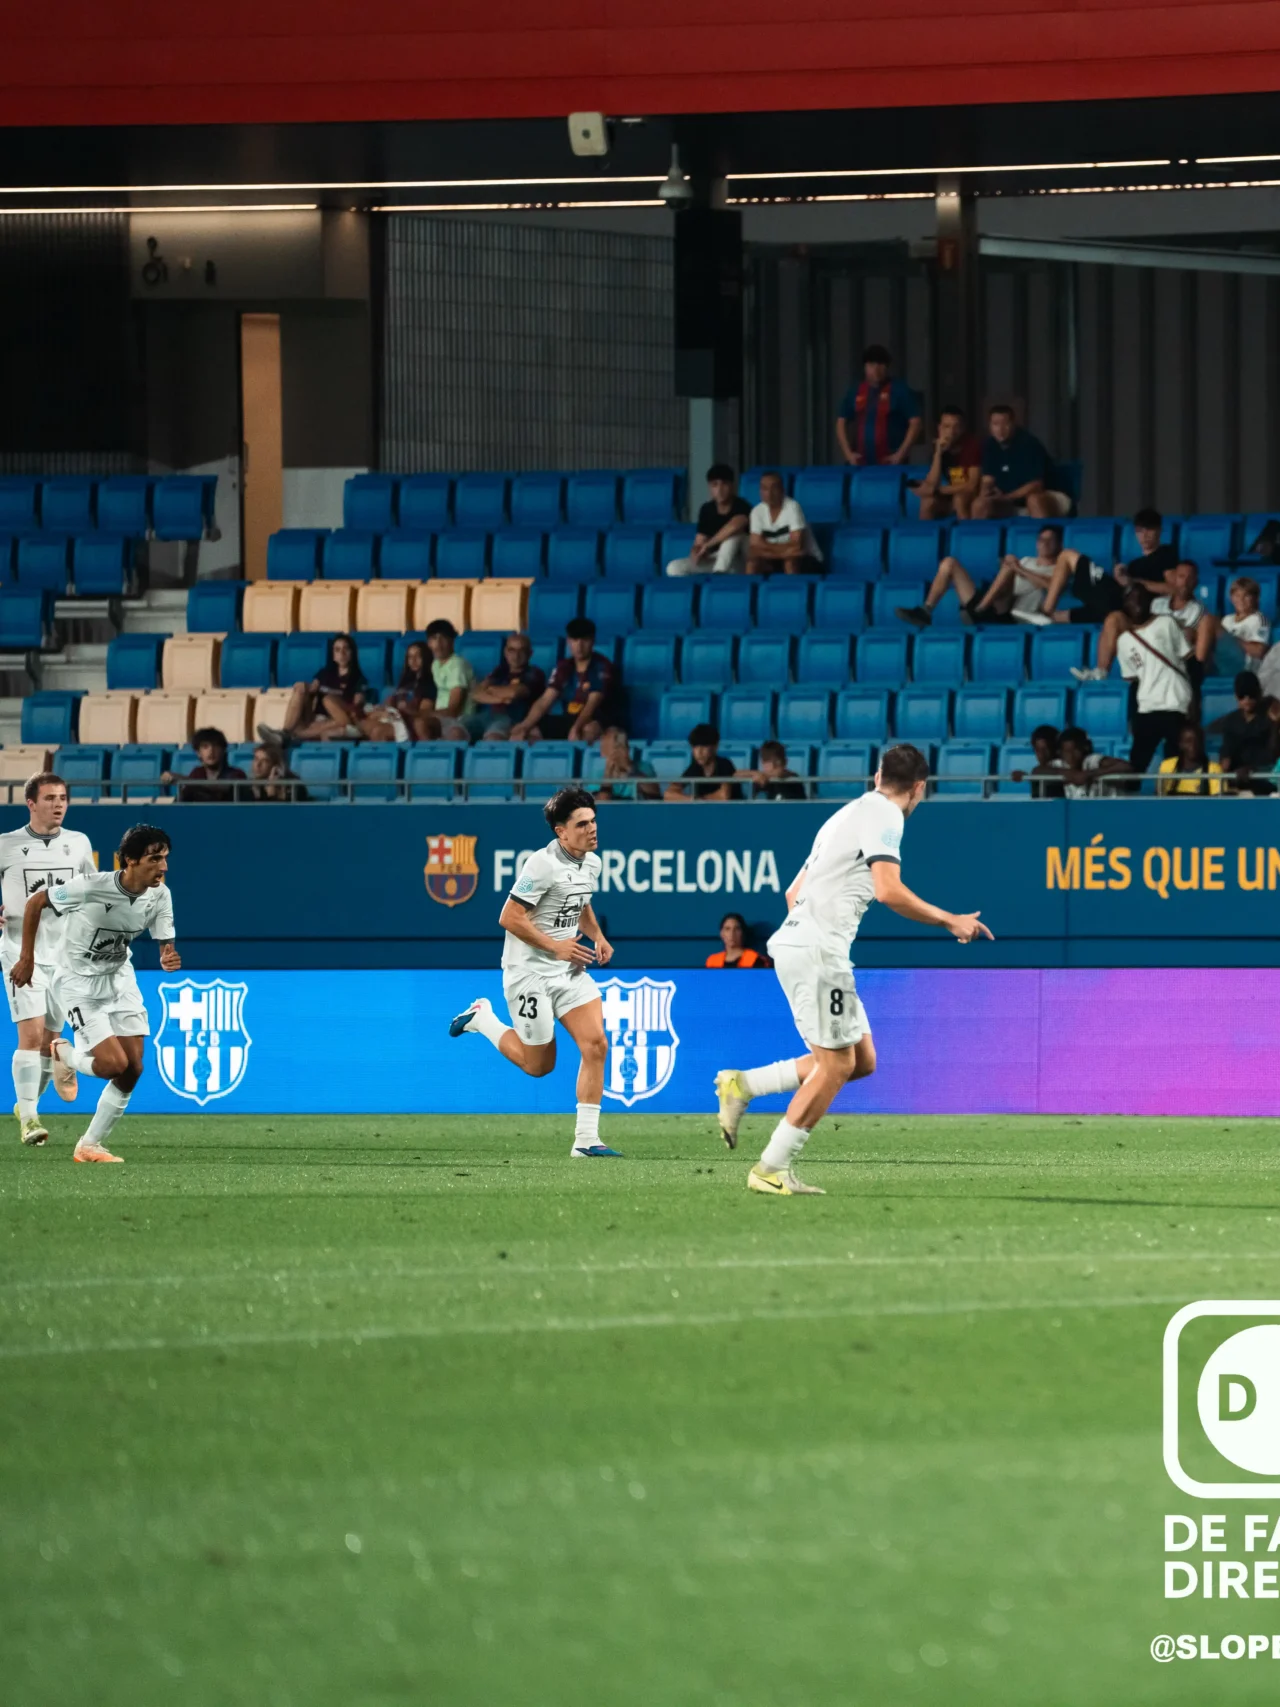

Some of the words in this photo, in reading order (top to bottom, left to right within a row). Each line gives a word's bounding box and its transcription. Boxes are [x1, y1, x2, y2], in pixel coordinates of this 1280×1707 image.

[592, 849, 780, 893] RCELONA
[1046, 833, 1132, 890] MÉS
[1143, 847, 1226, 899] QUE
[518, 994, 538, 1020] 23
[830, 988, 844, 1016] 8
[68, 1006, 86, 1032] 27
[185, 1031, 220, 1047] FCB
[611, 1031, 648, 1047] FCB
